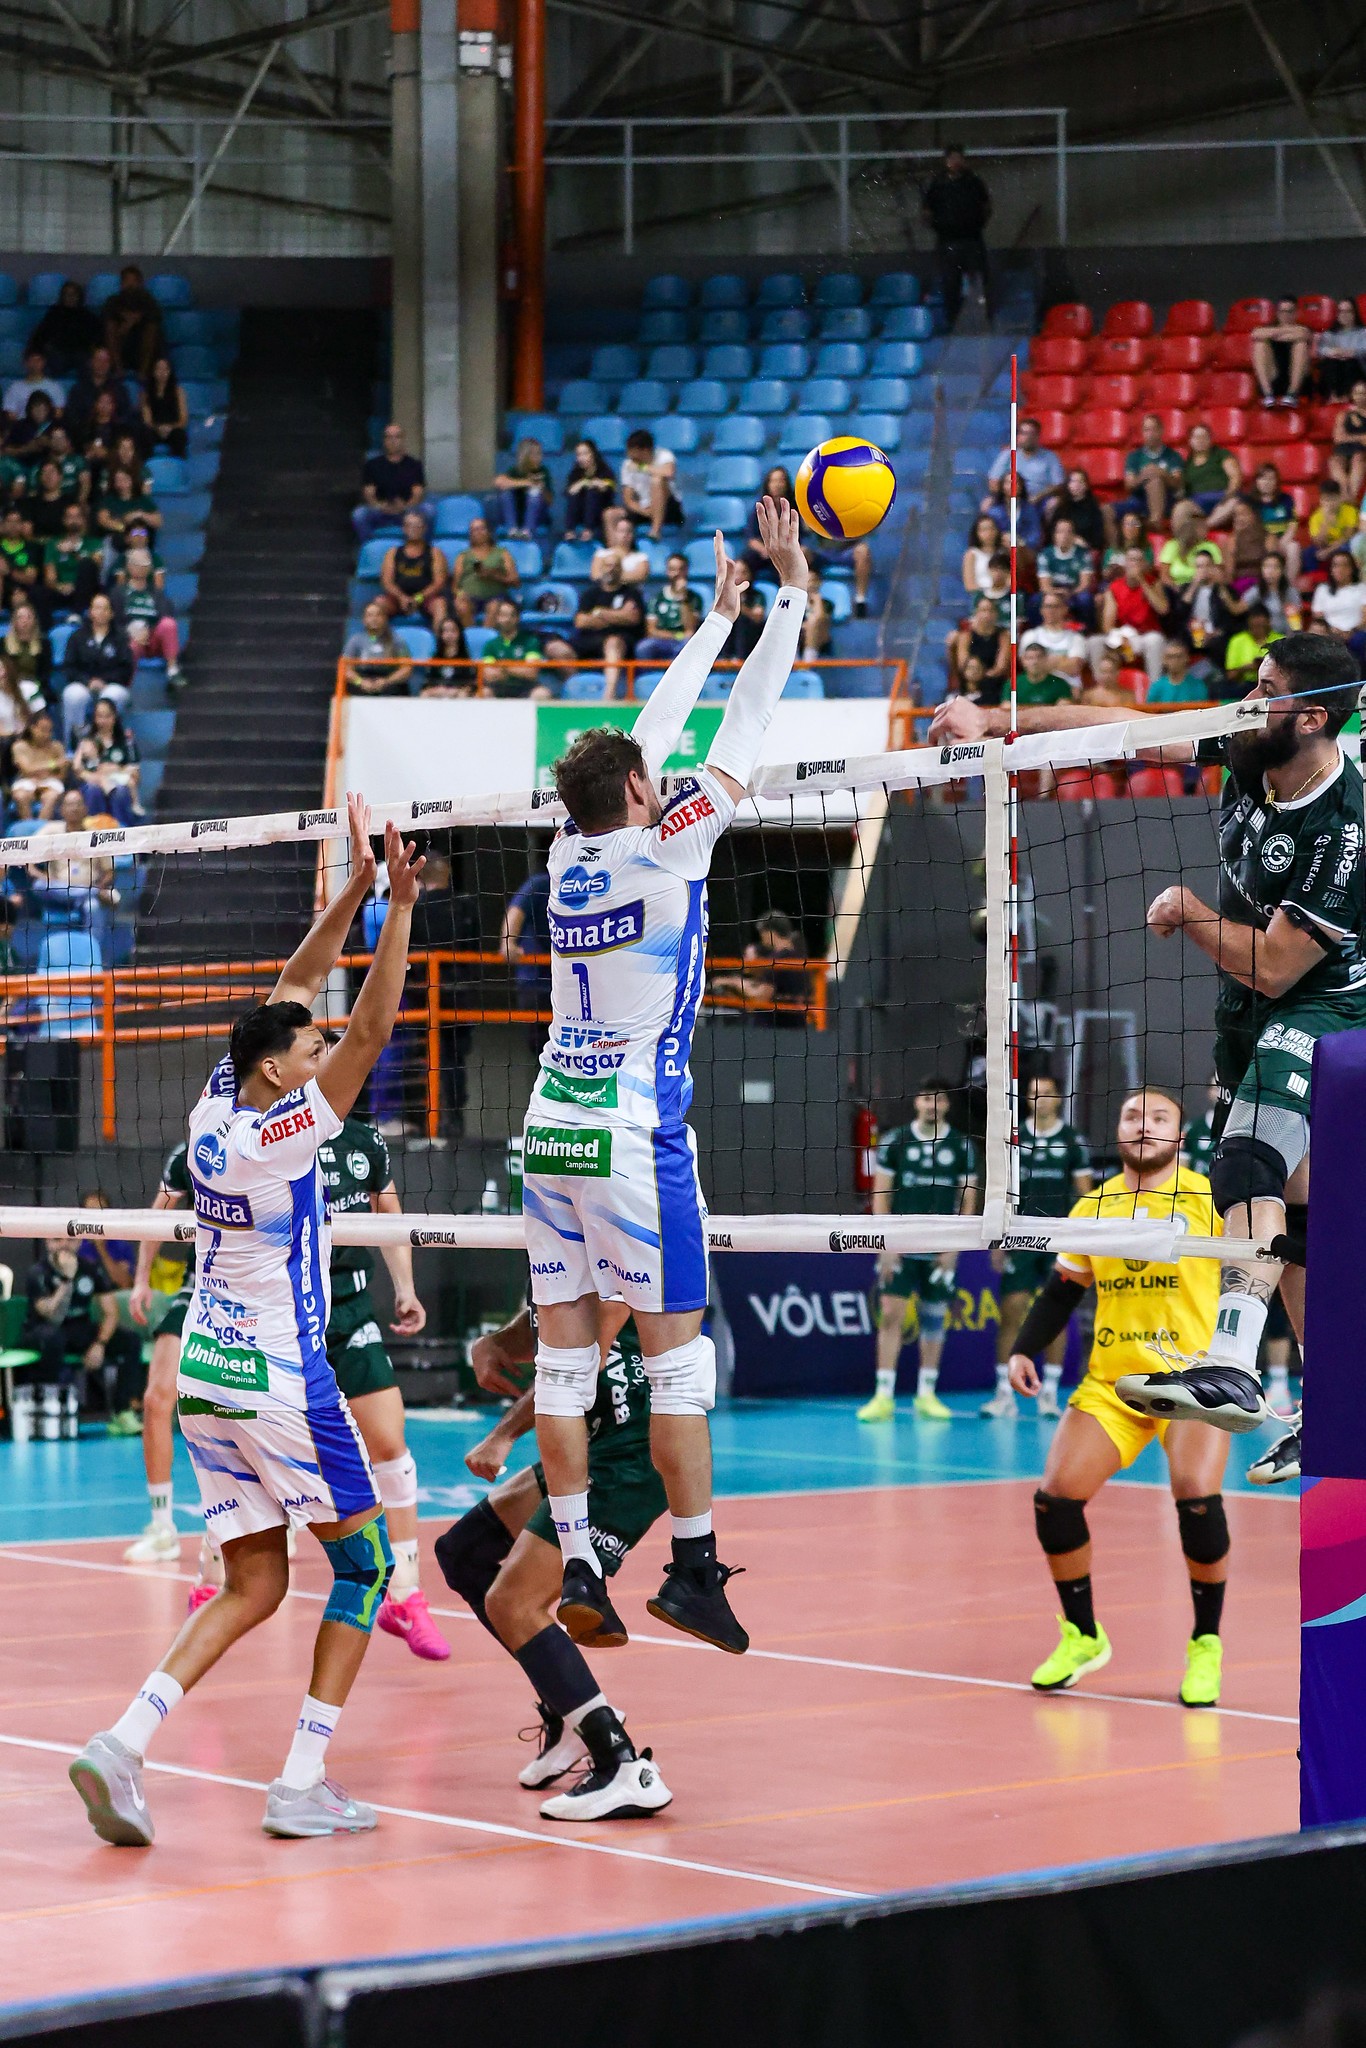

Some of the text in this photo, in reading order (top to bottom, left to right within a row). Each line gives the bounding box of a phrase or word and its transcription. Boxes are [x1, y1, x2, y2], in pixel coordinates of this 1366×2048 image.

[807, 759, 846, 776] SUPERLIGA
[419, 800, 453, 816] SUPERLIGA
[306, 812, 338, 828] SUPERLIGA
[660, 795, 716, 841] ADERE
[198, 820, 229, 835] SUPERLIGA
[2, 840, 29, 853] SUPERLIGA
[98, 831, 126, 845] SUPERLIGA
[1339, 822, 1359, 874] GOIÁS
[1301, 847, 1325, 892] SANEAGO
[560, 876, 605, 893] EMS
[571, 962, 592, 1021] 1
[664, 1015, 683, 1077] PUC
[260, 1107, 316, 1147] ADERE
[526, 1135, 600, 1159] Unimed
[196, 1144, 223, 1170] EMS
[565, 1160, 599, 1171] Campinas
[75, 1223, 105, 1237] SUPERLIGA
[420, 1231, 457, 1245] SUPERLIGA
[841, 1233, 886, 1251] SUPERLIGA
[1001, 1235, 1052, 1251] SUPERLIGA
[1140, 1275, 1180, 1290] LINE
[747, 1283, 873, 1337] VÔLEI
[1119, 1330, 1180, 1343] SANEAGO
[187, 1341, 256, 1375] Unimed
[221, 1371, 257, 1385] Campinas
